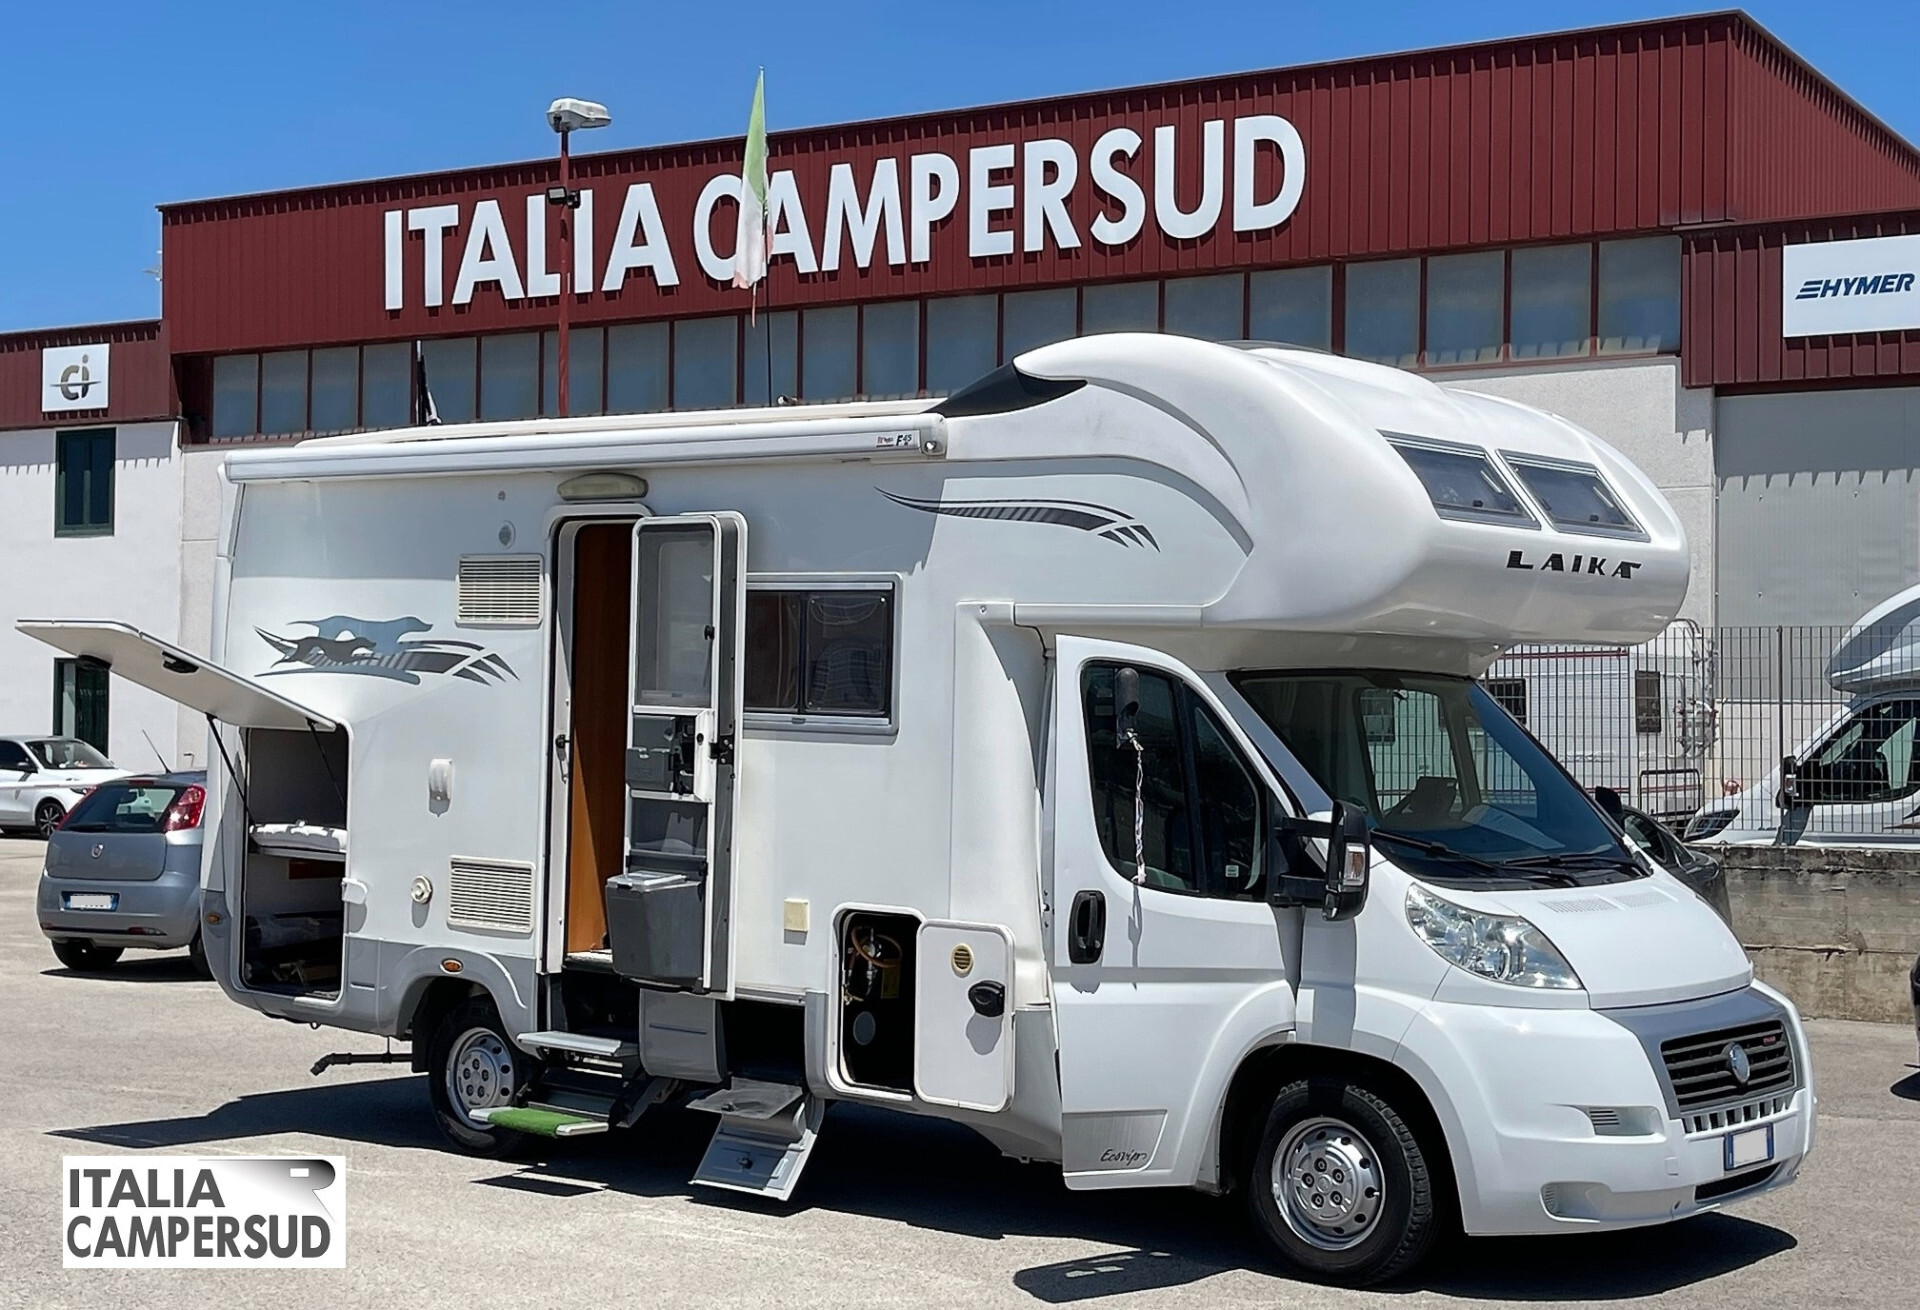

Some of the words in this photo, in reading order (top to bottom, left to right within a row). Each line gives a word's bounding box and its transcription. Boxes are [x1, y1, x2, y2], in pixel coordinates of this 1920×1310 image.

[384, 182, 680, 311] ITALIA
[693, 114, 1306, 282] CAMPERSUD
[1819, 273, 1916, 298] HYMER
[1506, 550, 1642, 579] LAIKA
